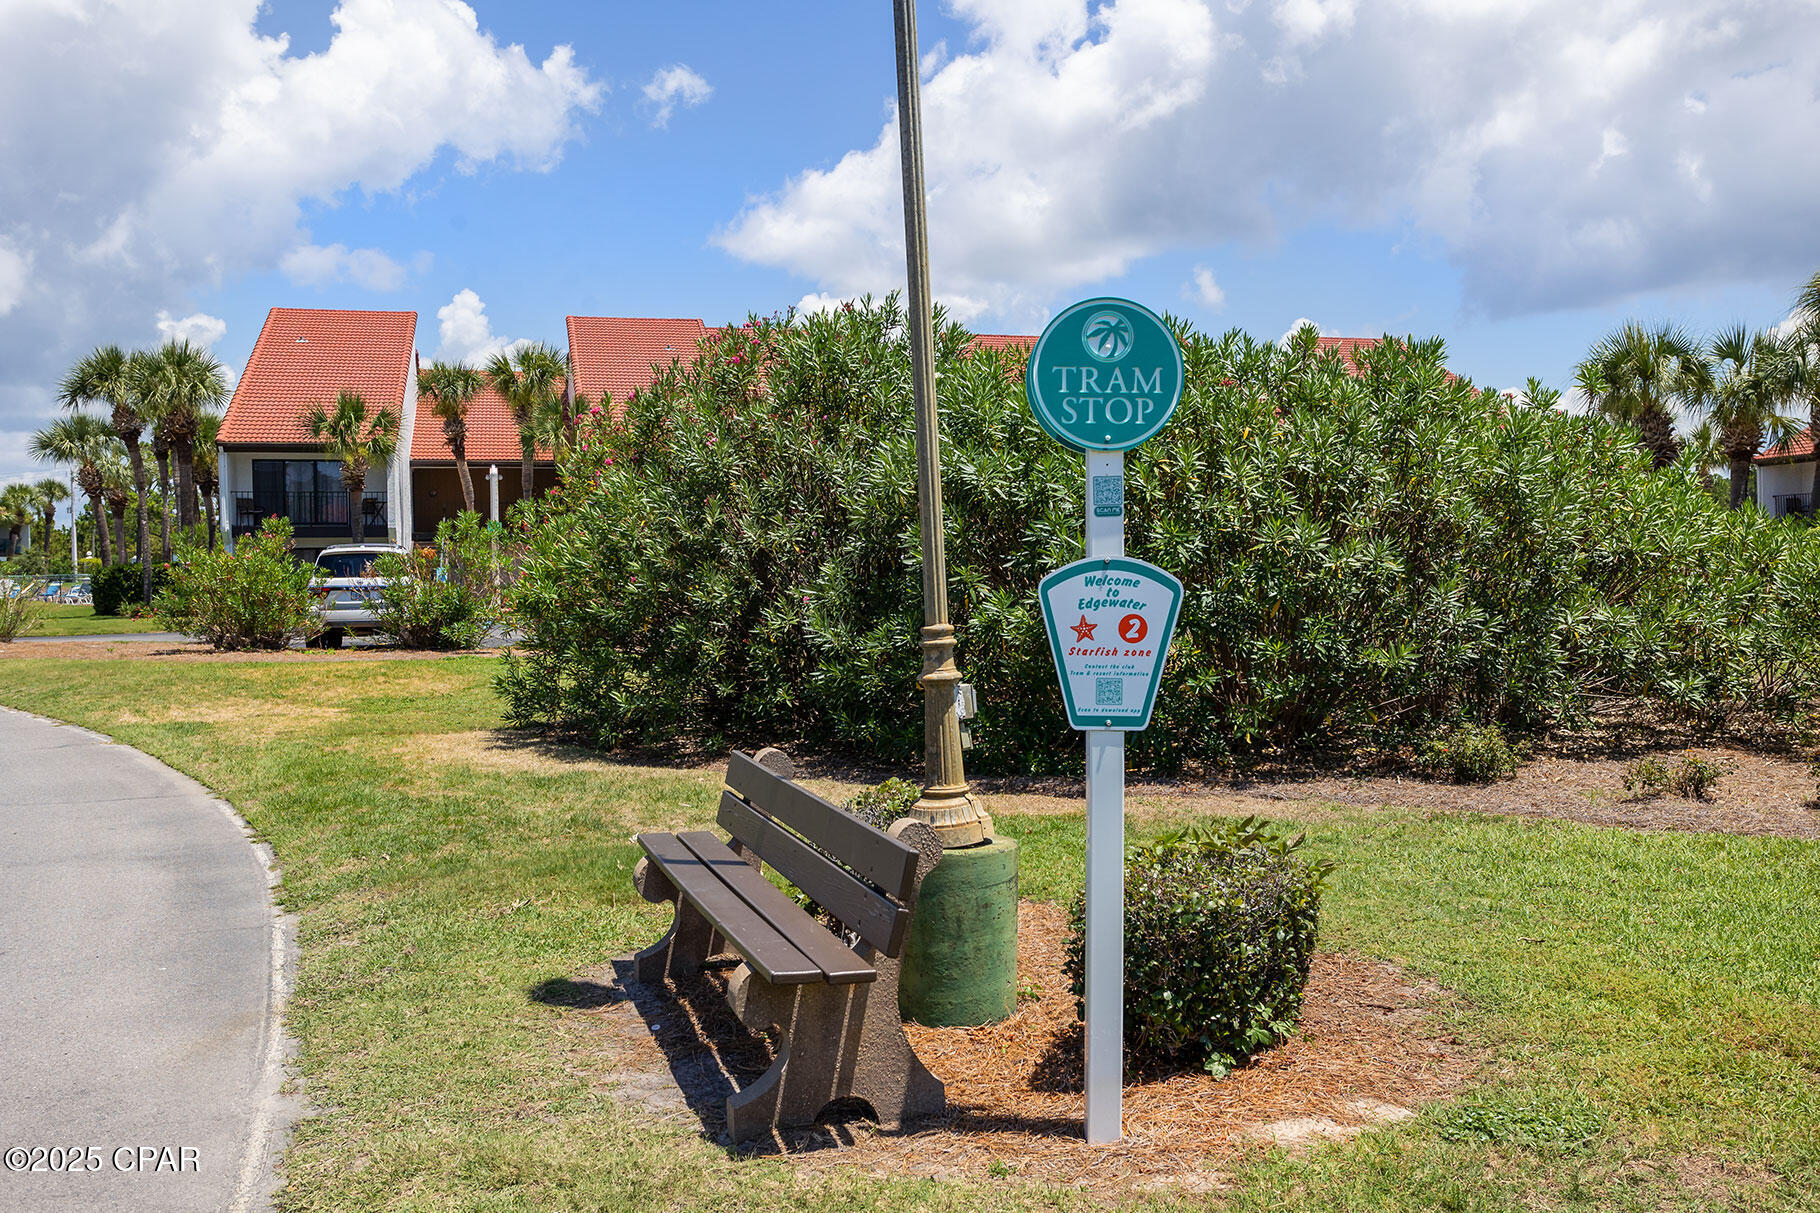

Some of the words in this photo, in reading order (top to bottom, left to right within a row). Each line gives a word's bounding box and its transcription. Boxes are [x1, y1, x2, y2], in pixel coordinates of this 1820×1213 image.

[1052, 366, 1163, 394] TRAM
[1061, 397, 1154, 424] STOP
[1084, 574, 1141, 588] Welcome
[1106, 587, 1120, 598] to
[1078, 597, 1147, 611] Edgewater
[1125, 618, 1141, 639] 2
[1068, 646, 1118, 656] Starfish
[1123, 649, 1152, 657] zone
